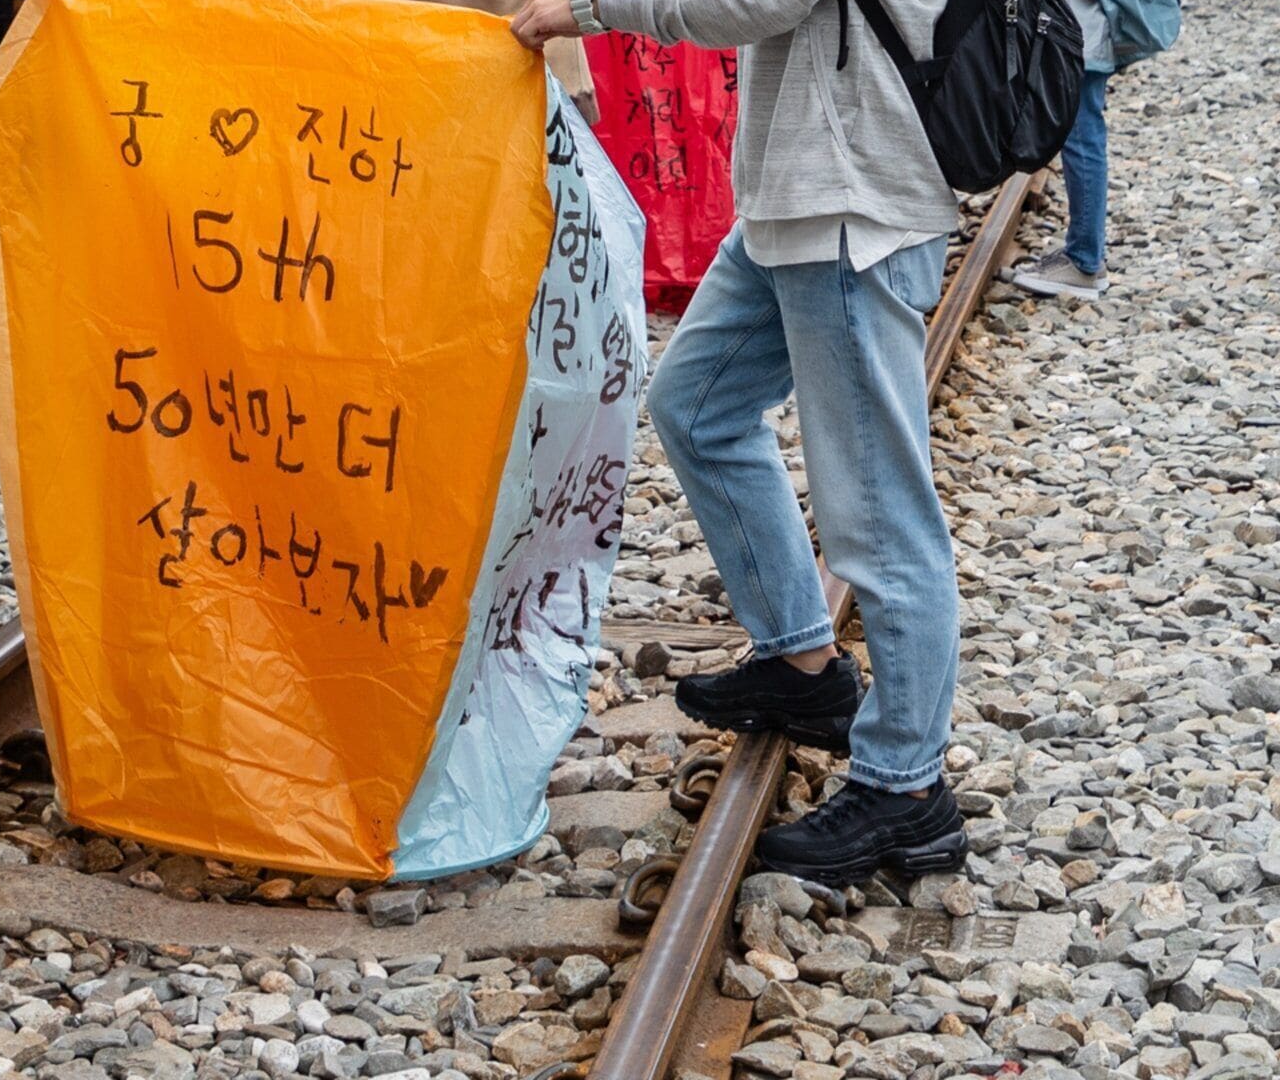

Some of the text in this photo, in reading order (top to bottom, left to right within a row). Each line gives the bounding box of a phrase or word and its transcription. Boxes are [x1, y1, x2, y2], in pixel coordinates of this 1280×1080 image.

[110, 80, 413, 197] 궁 진하
[166, 209, 336, 304] 15th
[106, 347, 402, 494] 50년만 더
